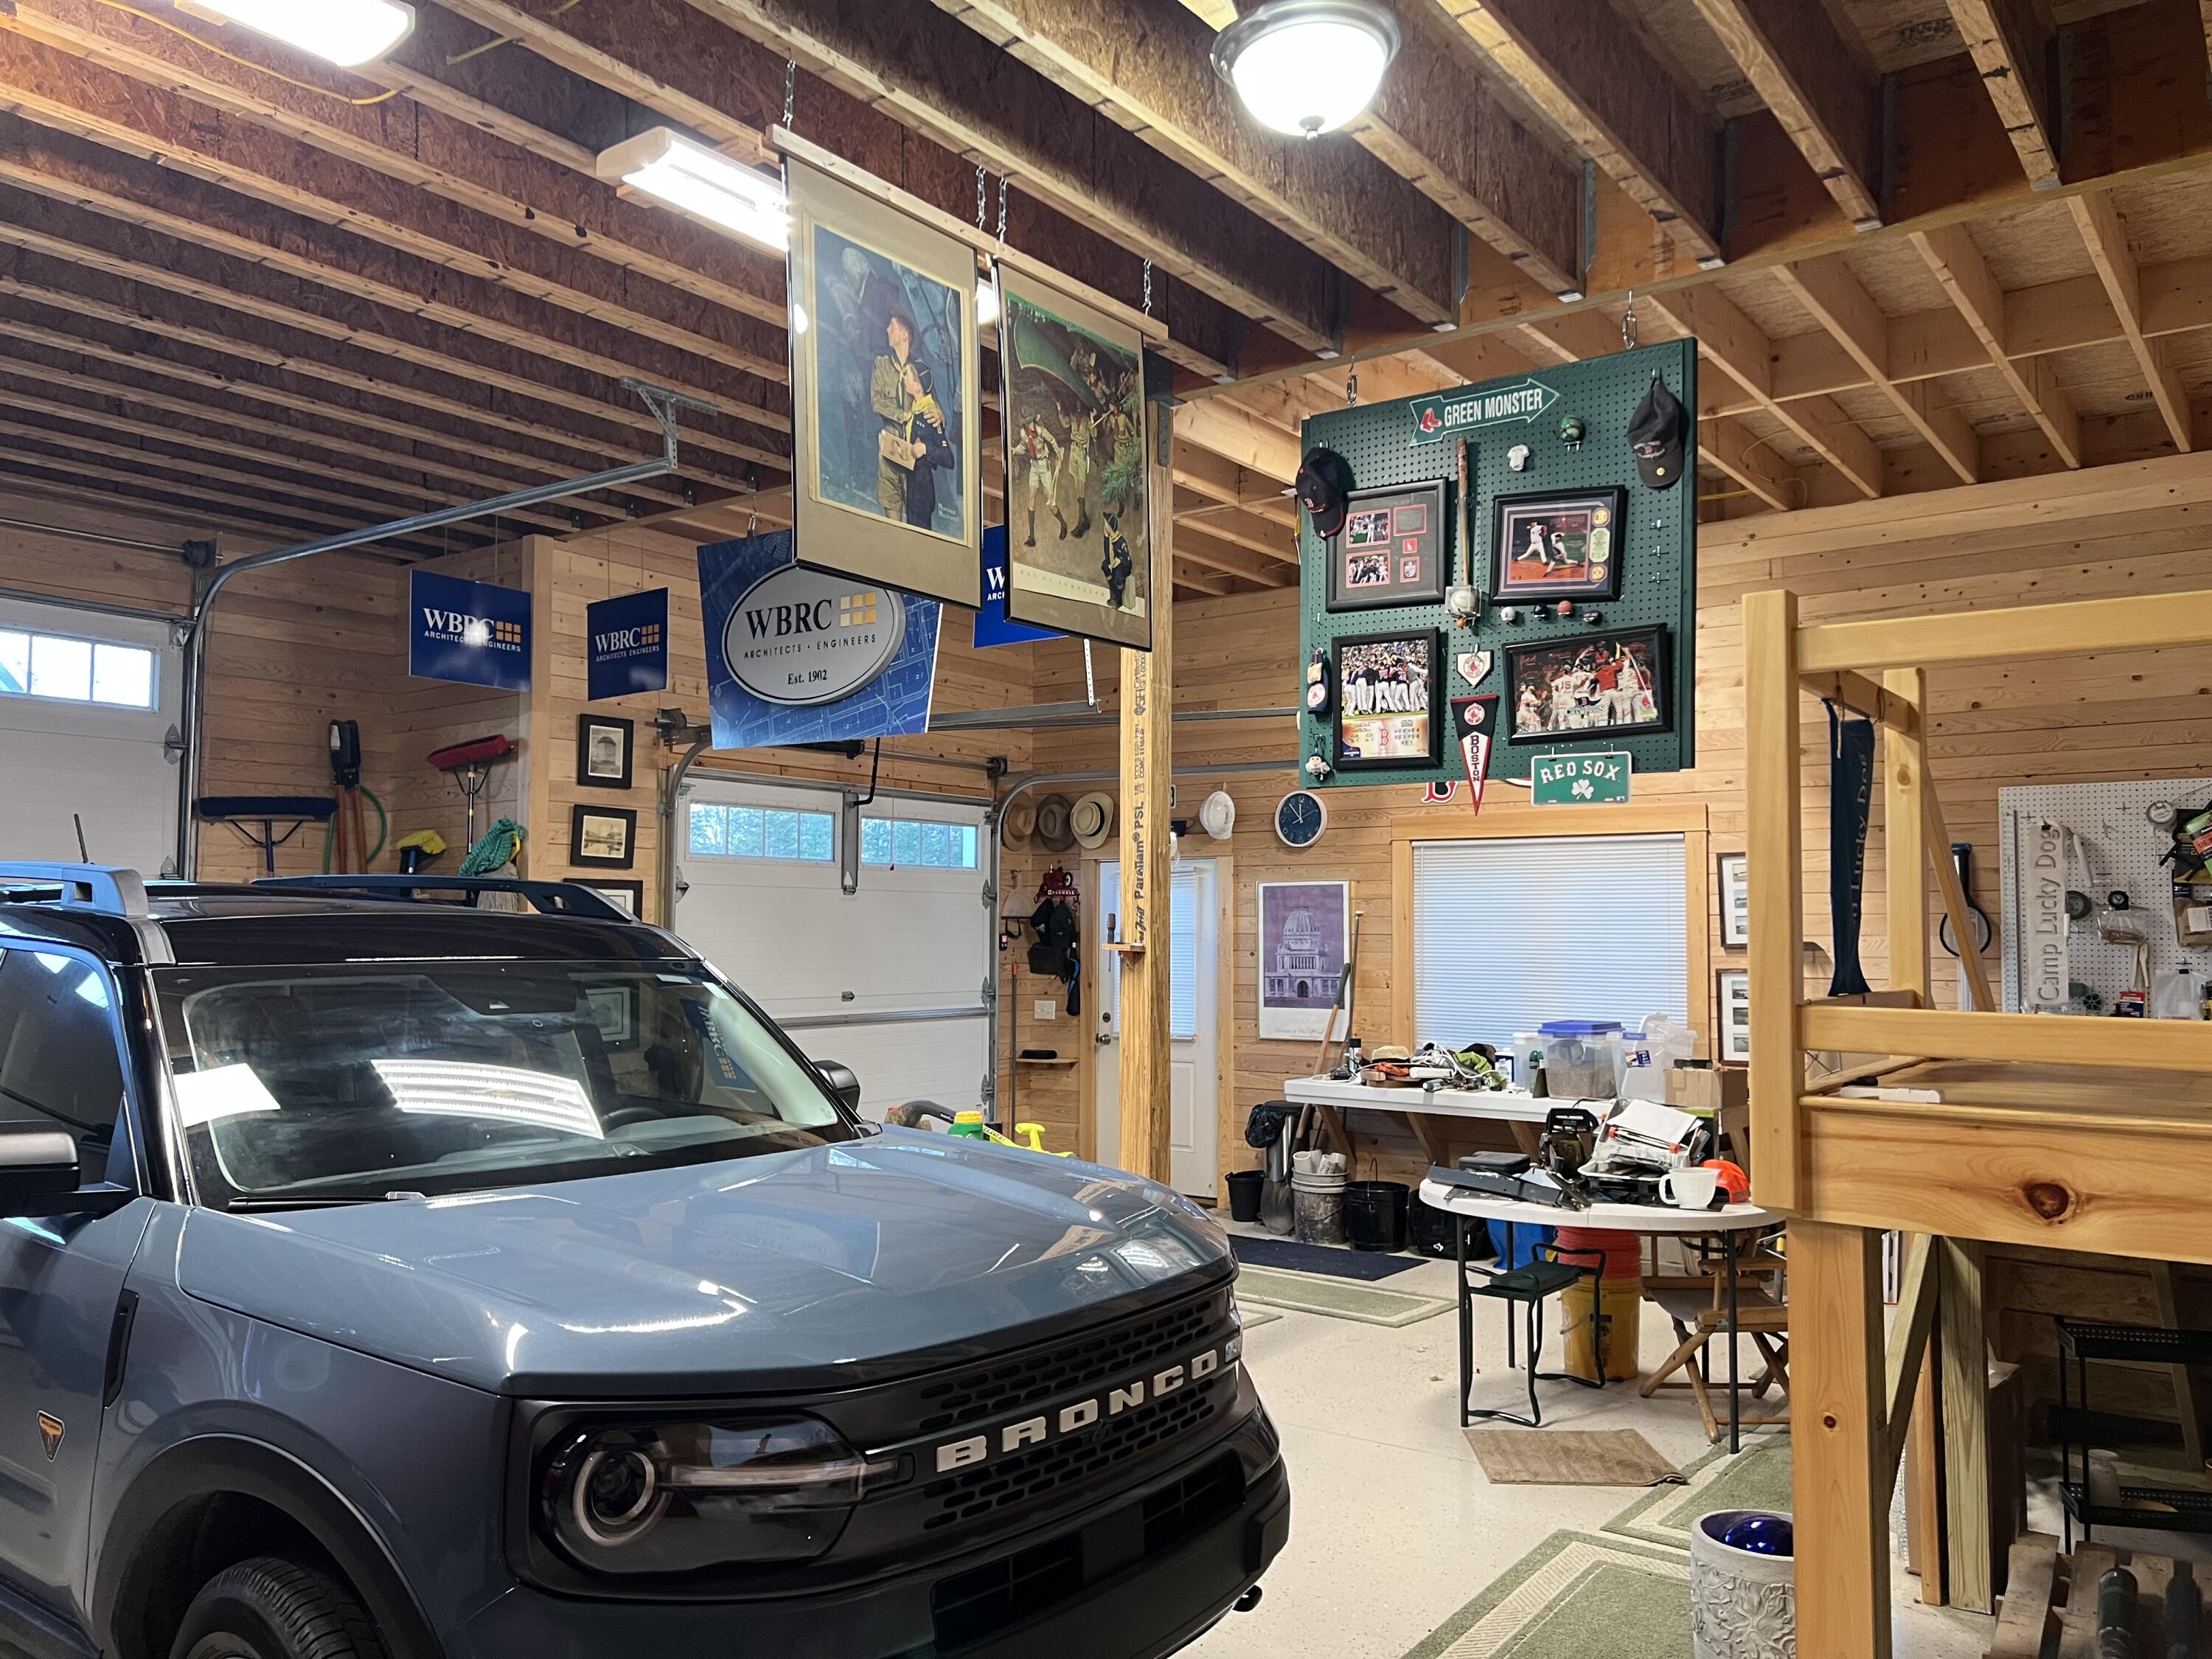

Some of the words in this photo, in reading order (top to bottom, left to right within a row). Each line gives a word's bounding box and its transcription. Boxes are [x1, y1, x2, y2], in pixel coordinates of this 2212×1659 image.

[1444, 402, 1481, 427] GREEN
[1485, 389, 1543, 419] MONSTER
[745, 599, 832, 639] WBRC
[425, 630, 475, 646] ARCHITEC
[479, 639, 521, 652] NGINEERS
[595, 627, 640, 653] WBRC
[595, 650, 627, 661] ARCHITECTS
[629, 644, 660, 656] ENGINEERS
[744, 644, 801, 658] ARCHITECTS
[817, 634, 876, 650] ENGINEERS
[787, 673, 804, 684] Est.
[808, 669, 827, 682] 1902
[1470, 734, 1480, 782] BOSTON
[1540, 762, 1576, 784] RED
[1582, 760, 1622, 781] SOX
[1133, 801, 1144, 830] PSL
[2035, 829, 2061, 869] Dog
[2035, 877, 2062, 935] Lucky
[2037, 944, 2062, 1001] Camp
[936, 1349, 1218, 1472] BRONCO
